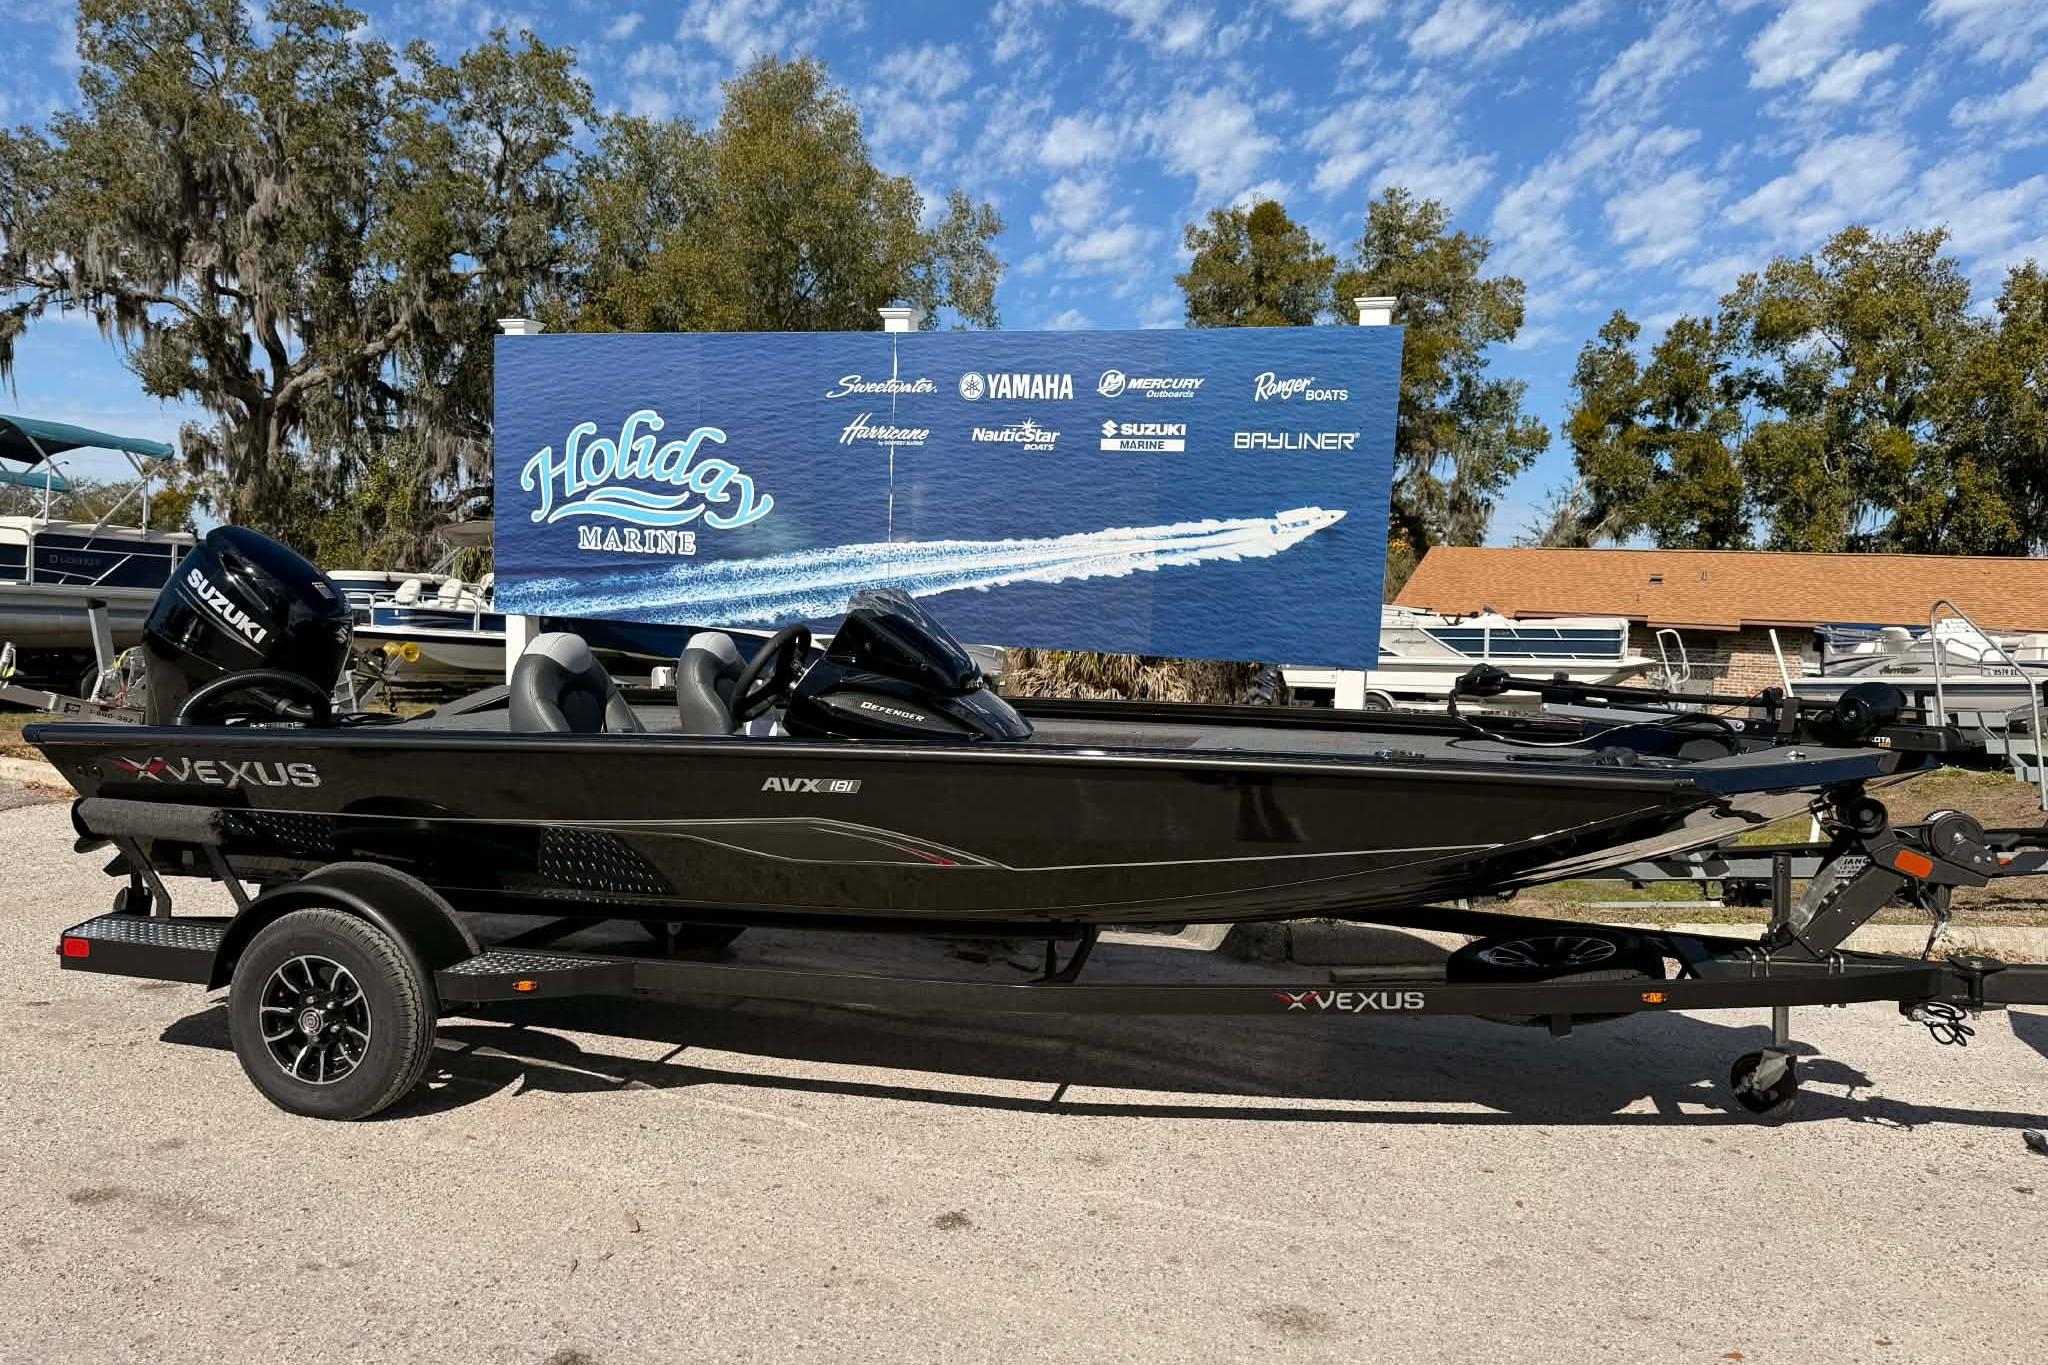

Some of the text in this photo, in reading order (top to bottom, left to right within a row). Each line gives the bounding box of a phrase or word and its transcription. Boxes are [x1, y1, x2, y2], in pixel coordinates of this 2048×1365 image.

[987, 374, 1073, 399] YAMAHA
[1128, 378, 1205, 389] MERCURY
[1146, 390, 1194, 398] Outboards
[1254, 371, 1312, 402] Ranger
[1306, 390, 1349, 401] BOATS
[839, 412, 930, 446] Hurricane
[971, 425, 1061, 443] NauticStar
[1120, 423, 1187, 436] SUZUKI
[1024, 443, 1055, 451] BOATS
[1119, 440, 1166, 450] MARINE
[520, 409, 774, 529] Holiday
[577, 526, 696, 555] MARINE
[186, 568, 268, 644] SUZUKI
[860, 701, 927, 722] DEFENDER
[160, 756, 321, 789] VEXUS
[761, 777, 853, 793] AVX 181
[1312, 990, 1425, 1013] VEXUS
